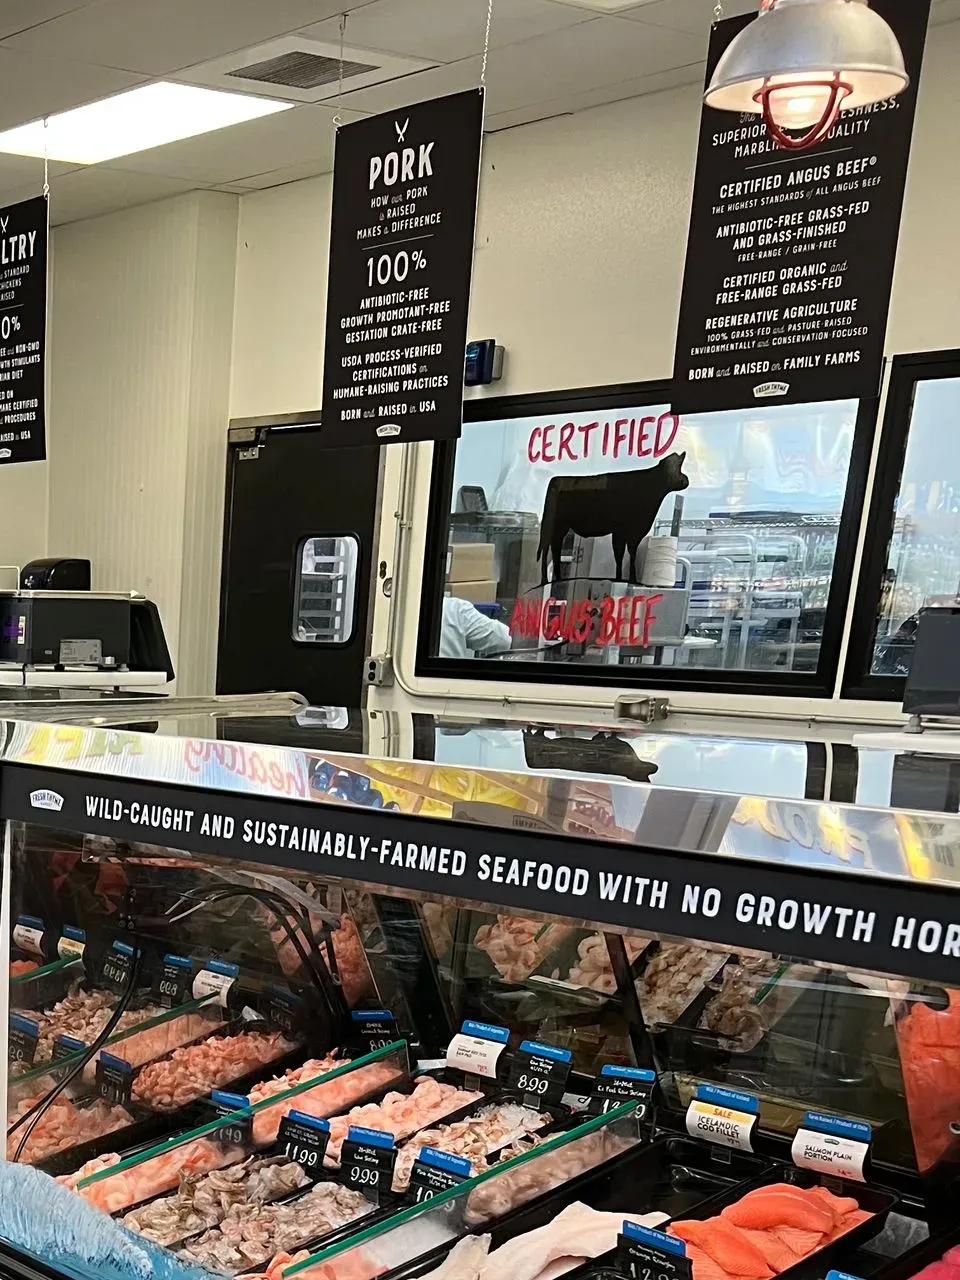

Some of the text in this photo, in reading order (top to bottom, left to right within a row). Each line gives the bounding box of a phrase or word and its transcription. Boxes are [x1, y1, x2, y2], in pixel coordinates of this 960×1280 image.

[712, 123, 767, 146] SUPERIOR
[369, 142, 434, 190] PORK
[712, 176, 882, 215] THE HIGHEST STANDARDS ALL ANGUS BEEF
[719, 165, 831, 199] CERTIFIED ANGUS
[371, 186, 428, 208] HOW PORK
[387, 203, 416, 219] RAISED
[716, 201, 870, 239] ANTIBIOTIC-FREE GRASS-FED
[357, 212, 442, 240] MAKES DIFFERENCE
[733, 221, 847, 250] AND GRASS-FINISHED
[737, 239, 837, 263] FREE-RANGE GRAIN-FREE
[367, 250, 427, 287] 100%
[723, 270, 775, 289] CERTIFIED
[779, 262, 826, 280] ORGANIC
[360, 287, 430, 310] ANTIBIOTIC-FREE
[715, 275, 842, 305] FREE-RANGE GRASS-FED
[340, 300, 450, 329] GROWTH PROMOTANT-FREE
[705, 298, 858, 330] REGENERATIVE AGRICULTURE
[346, 318, 442, 344] GESTATION CRATE-FREE
[690, 326, 868, 356] ENVIRONMENTALLY CONSERVATION-FOCUSED
[707, 316, 852, 343] 100% GRASS-FED PASTURE-RAISED
[341, 343, 442, 367] USDA PROCESS-VERIFIED
[688, 366, 714, 380] BORN
[733, 360, 769, 376] RAISED
[783, 354, 821, 370] FAMILY
[825, 351, 860, 365] FARMS
[352, 363, 417, 381] CERTIFICATIONS
[333, 375, 449, 399] HUMANE-RAISING PRACTICES
[340, 400, 436, 421] BORN RAISED USA
[20, 430, 31, 440] USA
[528, 412, 680, 464] CERTIFIED
[509, 592, 664, 647] ANGUS BEEF
[84, 795, 194, 833] WILD-CAUGHT
[199, 813, 237, 841] AND
[241, 819, 467, 878] SUSTAINABLY-FARMED
[477, 852, 590, 896] SEAFOOD
[598, 872, 668, 908] WITH
[682, 884, 722, 918] NO
[735, 892, 877, 943] GROWTH
[698, 1116, 739, 1131] ICELANDIC
[713, 1108, 733, 1118] SALE
[697, 1123, 739, 1139] COD FILLET
[804, 1151, 832, 1162] PORTION
[805, 1145, 852, 1160] SALMON PLAIN
